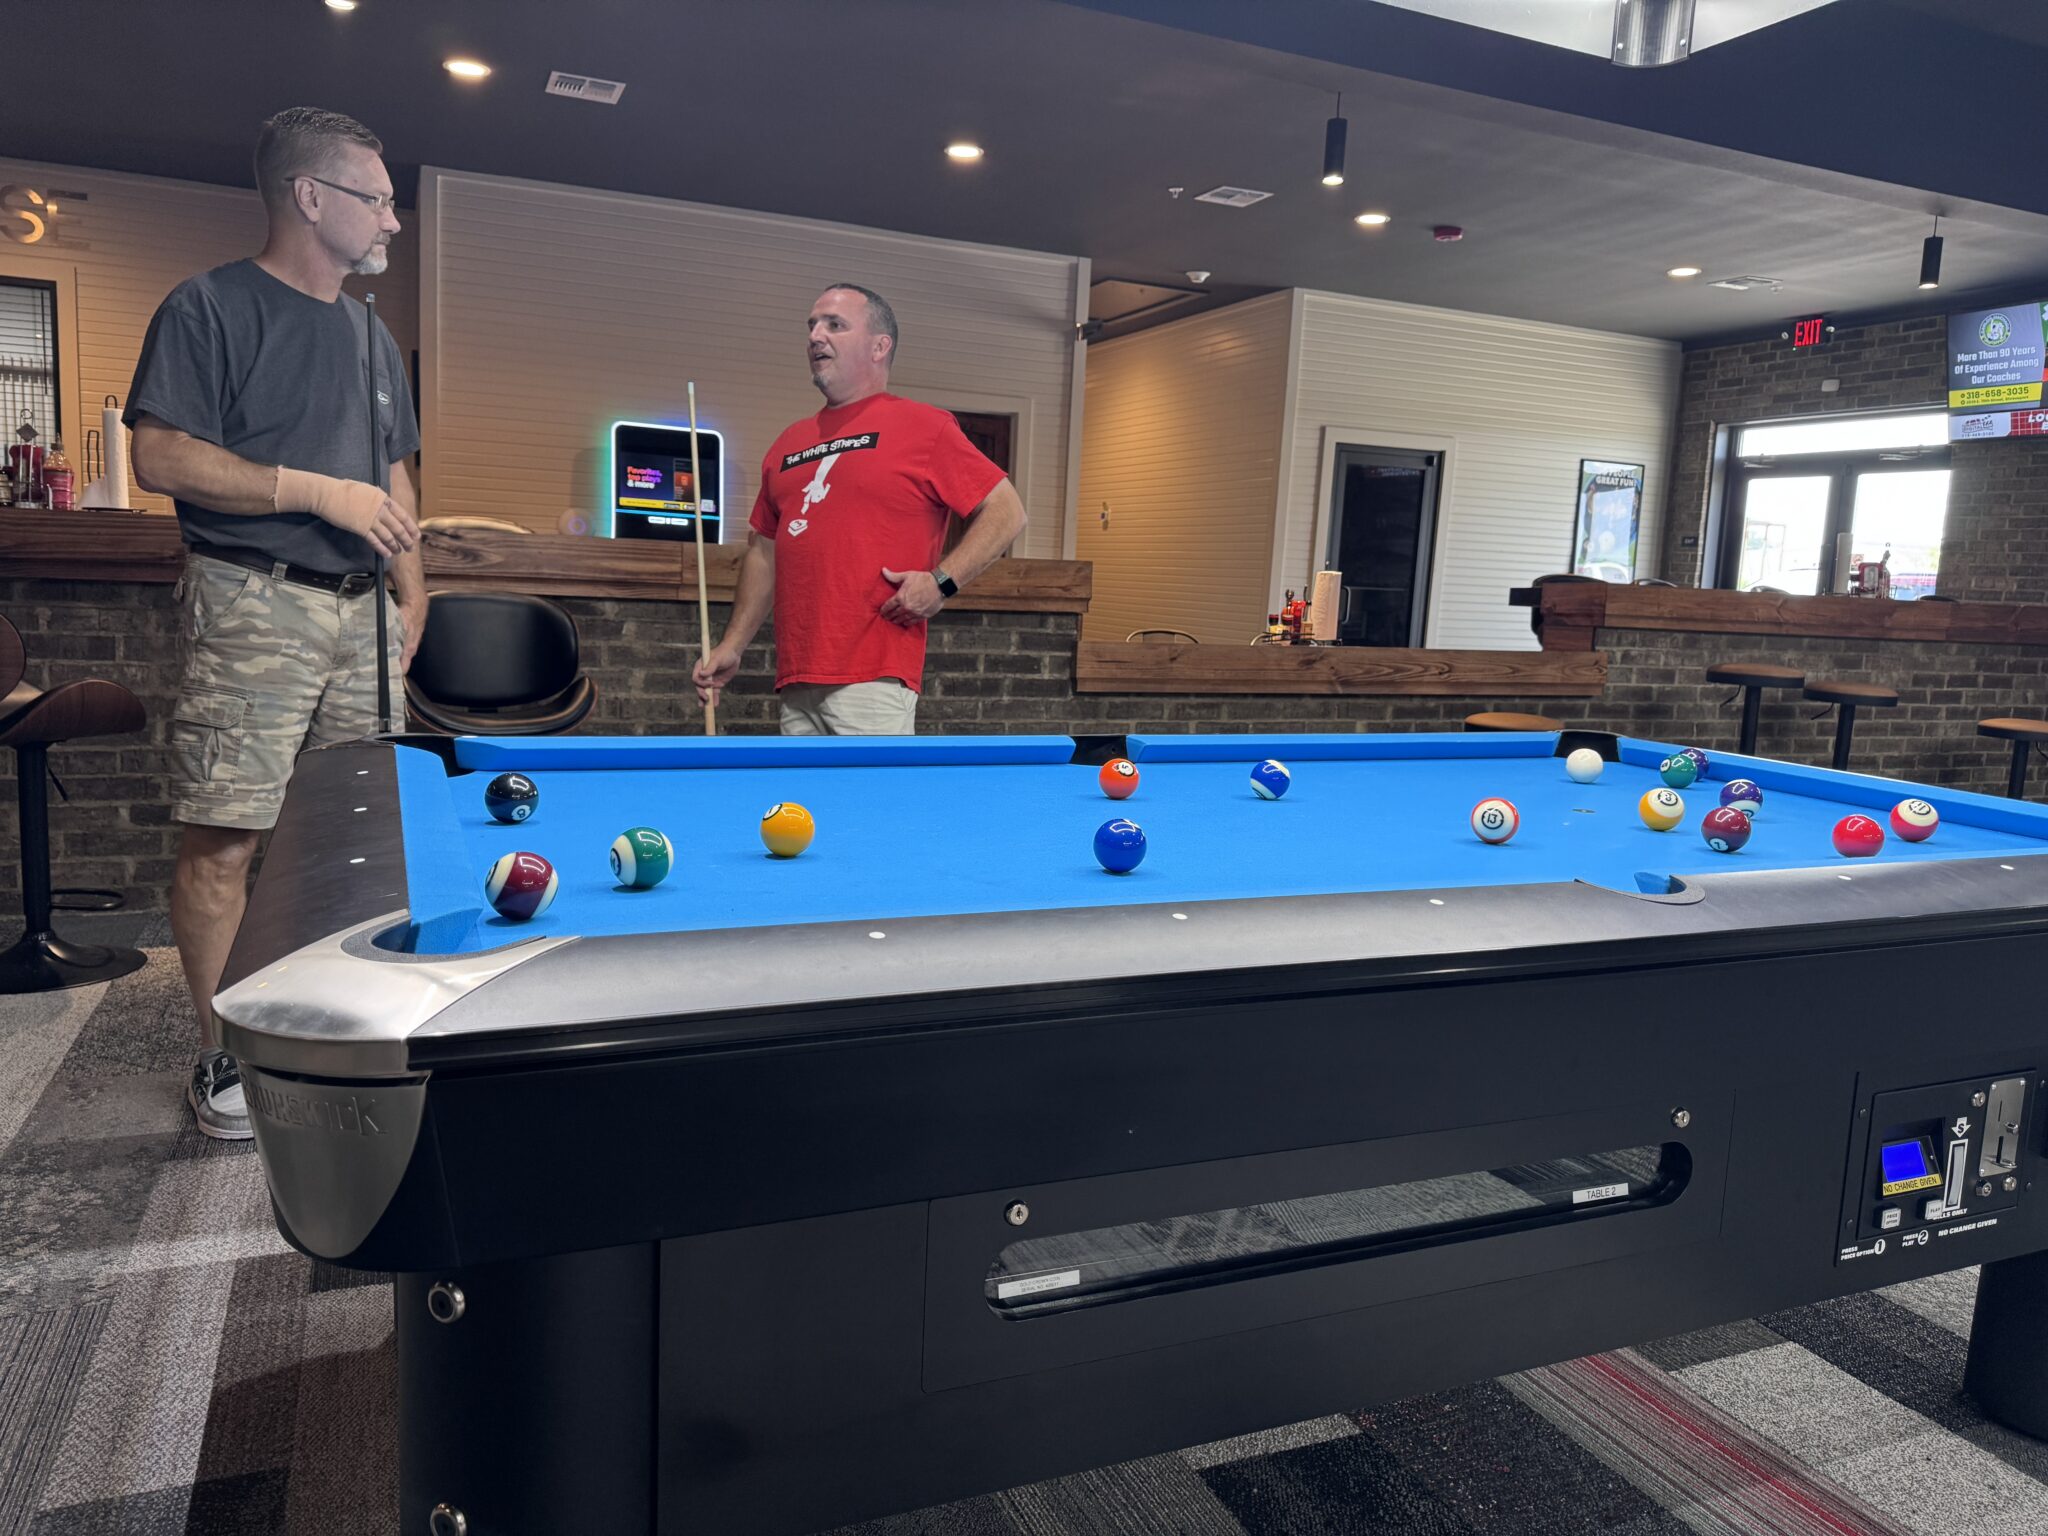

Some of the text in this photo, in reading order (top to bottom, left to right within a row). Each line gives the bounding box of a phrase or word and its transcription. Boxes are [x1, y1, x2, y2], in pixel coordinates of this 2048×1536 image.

[1794, 318, 1823, 347] EXIT
[1957, 346, 2036, 363] More Than 90 Years
[1954, 358, 2039, 374] Of Experience Among
[1971, 372, 2021, 384] Our Coaches
[1966, 386, 2029, 399] 318-658-3035
[786, 435, 871, 465] THE WHITE STRIPES
[1595, 475, 1619, 486] GREAT
[1487, 813, 1498, 824] 13
[1883, 1177, 1937, 1194] NO CHANGE GIVEN
[1587, 1186, 1616, 1199] TABLE 2
[1951, 1208, 1968, 1216] ONLY
[1949, 1223, 1976, 1234] CHANGE
[1976, 1218, 1998, 1228] GIVEN
[1902, 1233, 1918, 1241] PRESS
[1840, 1253, 1856, 1261] PRICE
[1856, 1249, 1875, 1257] OPTION
[1841, 1246, 1858, 1254] PRESS
